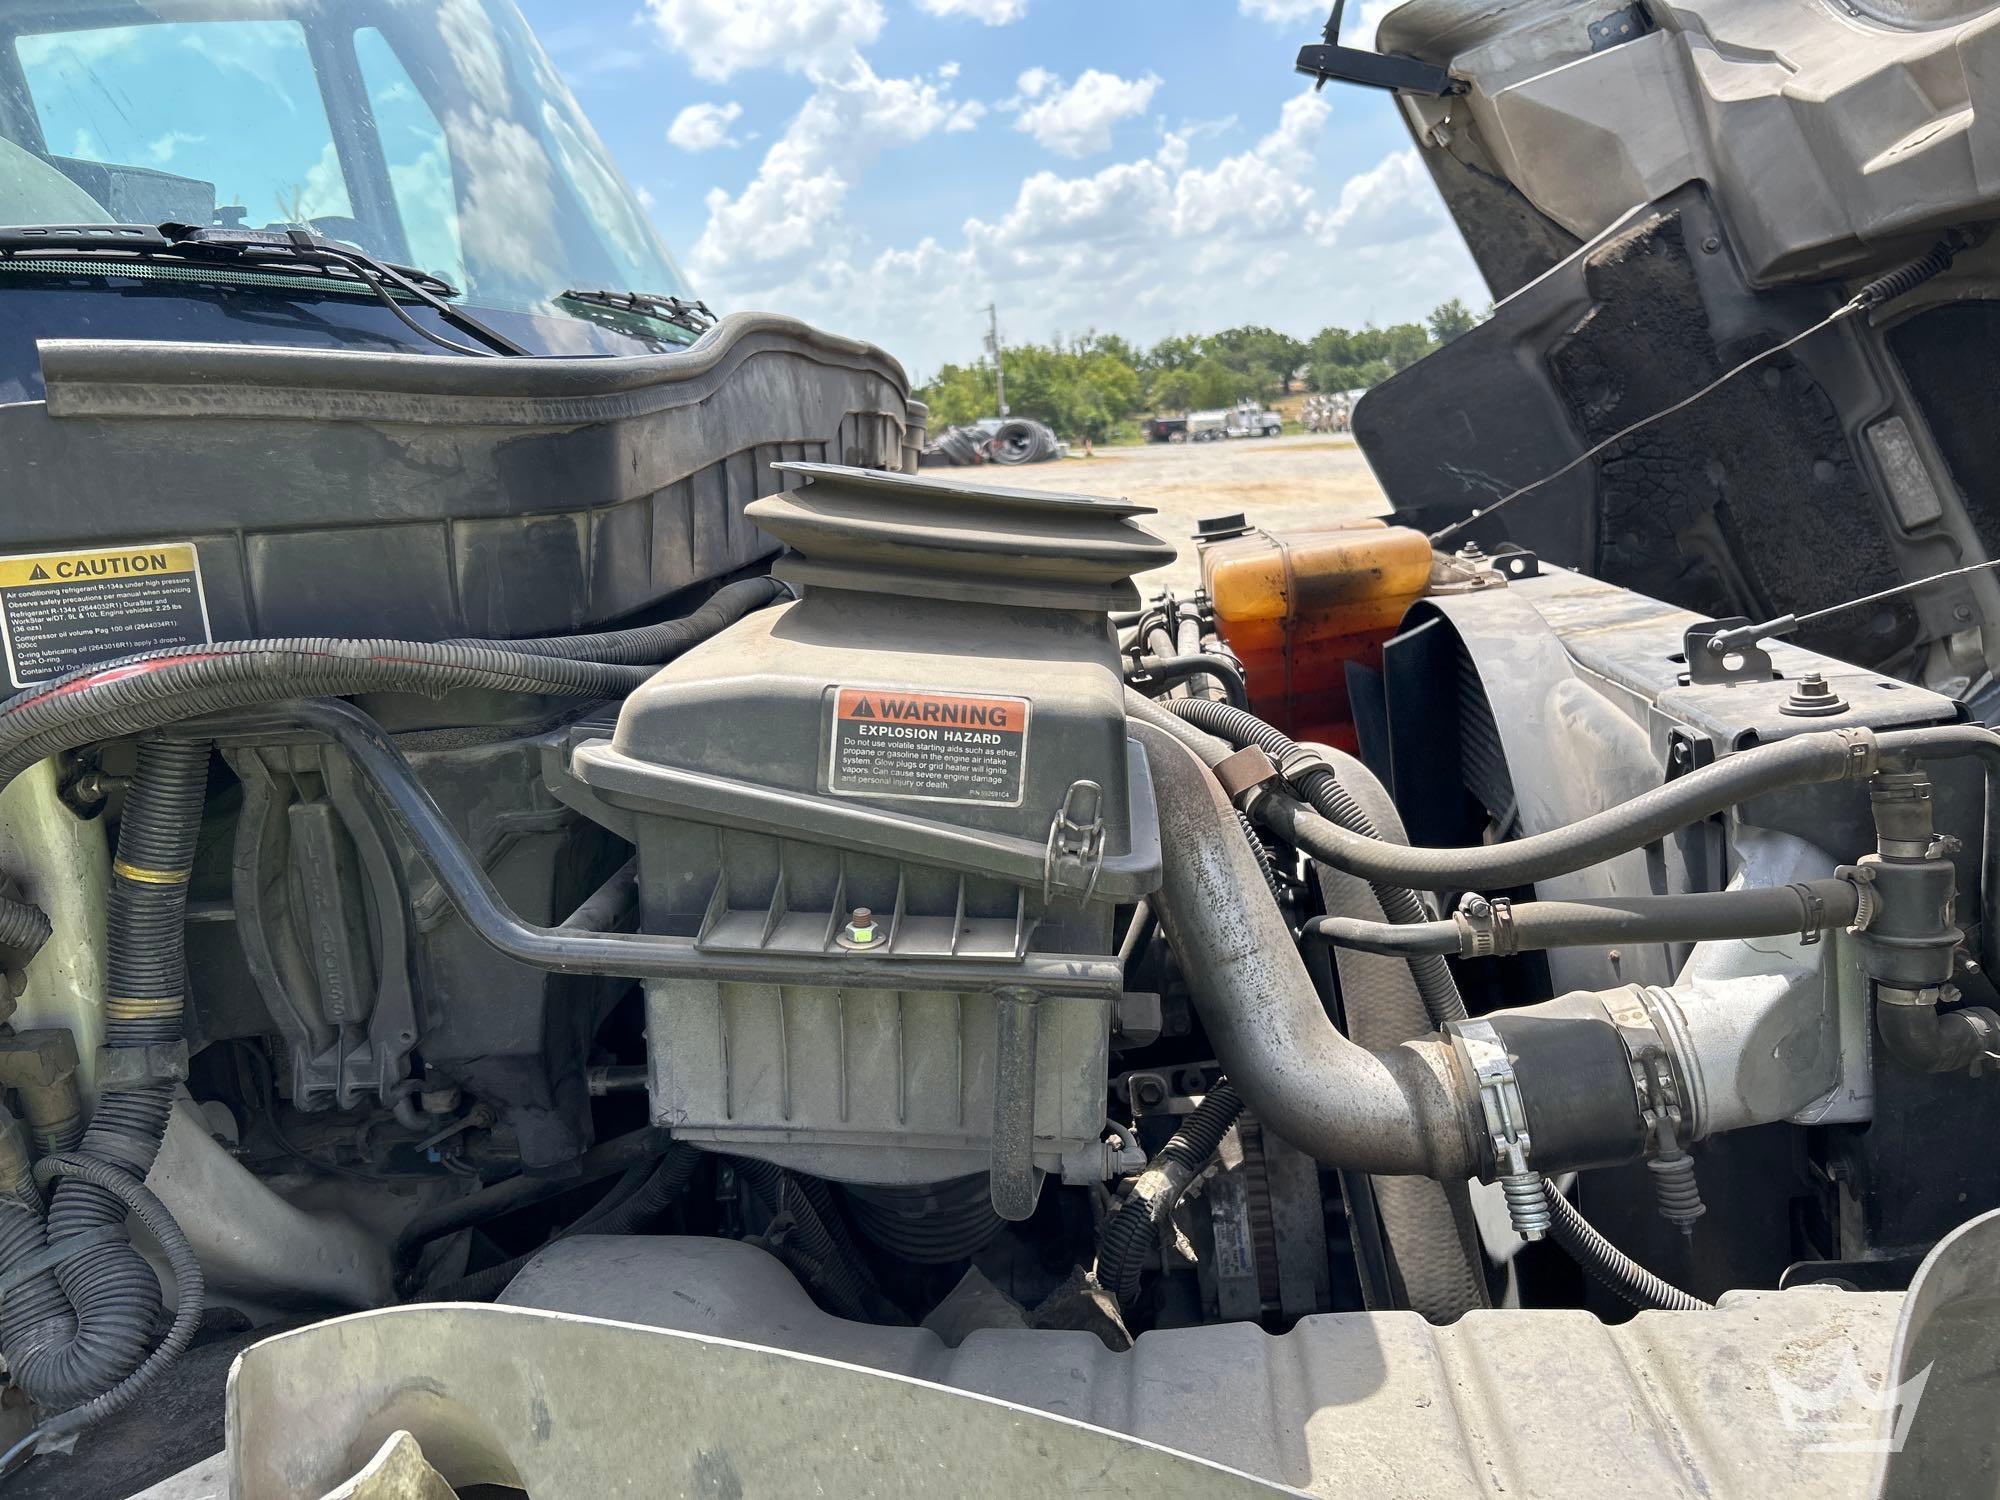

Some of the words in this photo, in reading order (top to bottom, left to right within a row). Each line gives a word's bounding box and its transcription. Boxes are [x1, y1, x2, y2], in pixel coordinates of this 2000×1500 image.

[56, 554, 167, 578] CAUTION
[18, 588, 60, 598] conditioning
[62, 585, 97, 595] refrigerant
[98, 583, 124, 591] R-134a
[145, 580, 160, 588] high
[161, 578, 190, 586] pressure
[8, 601, 38, 609] Observe
[62, 594, 102, 604] precautions
[103, 593, 115, 601] per
[116, 590, 141, 598] manual
[161, 587, 191, 595] servicing
[10, 609, 49, 618] Refrigerant
[50, 606, 76, 614] R-134a
[123, 599, 153, 607] DuraStar
[11, 616, 45, 625] WorkStar
[100, 609, 124, 617] Engine
[13, 625, 25, 633] (36
[14, 633, 57, 642] Compressor
[68, 628, 94, 637] volume
[16, 642, 37, 650] 300cc
[18, 651, 40, 659] O-ring
[41, 647, 77, 656] lubricating
[133, 639, 152, 647] apply
[159, 636, 178, 644] drops
[21, 667, 53, 675] Contains
[66, 663, 80, 671] Dye
[880, 699, 1007, 727] WARNING
[859, 725, 938, 740] EXPLOSION
[944, 730, 1002, 744] HAZARD
[844, 737, 856, 745] Do
[887, 741, 915, 749] volatile
[916, 742, 945, 753] starting
[947, 745, 963, 753] aids
[996, 749, 1018, 757] ether,
[843, 748, 875, 756] propane
[886, 751, 919, 759] gasoline
[943, 755, 969, 763] engine
[983, 757, 1007, 765] intake
[842, 757, 872, 765] system.
[874, 758, 894, 766] Glow
[896, 760, 917, 769] plugs
[928, 763, 943, 771] grid
[945, 764, 970, 772] heater
[971, 765, 984, 773] will
[985, 767, 1007, 775] ignite
[858, 776, 891, 784] personal
[893, 779, 914, 788] injury
[925, 781, 950, 789] death.
[872, 767, 889, 775] Can
[916, 771, 942, 779] severe
[943, 773, 970, 782] engine
[971, 775, 1003, 784] damage
